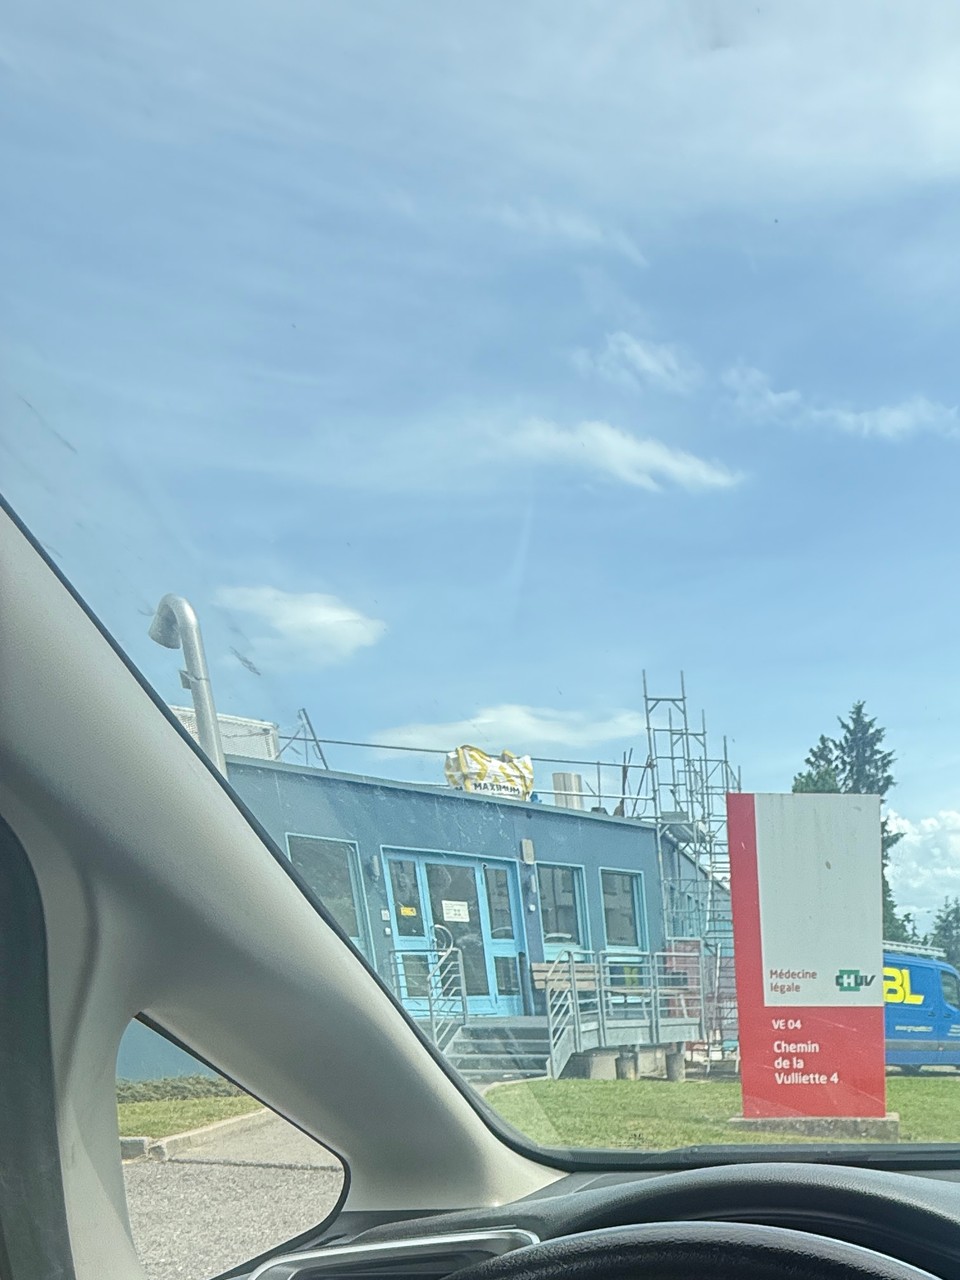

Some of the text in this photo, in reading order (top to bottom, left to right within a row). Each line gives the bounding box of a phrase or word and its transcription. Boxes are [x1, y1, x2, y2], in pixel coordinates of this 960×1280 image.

[473, 783, 520, 794] MAXIMUM
[770, 968, 817, 979] Médecine
[835, 974, 876, 987] CHUV
[770, 983, 801, 994] légale
[772, 1019, 801, 1029] VE 04
[773, 1040, 819, 1053] Chemin
[774, 1057, 804, 1069] de la
[775, 1072, 839, 1084] Vulliette 4
